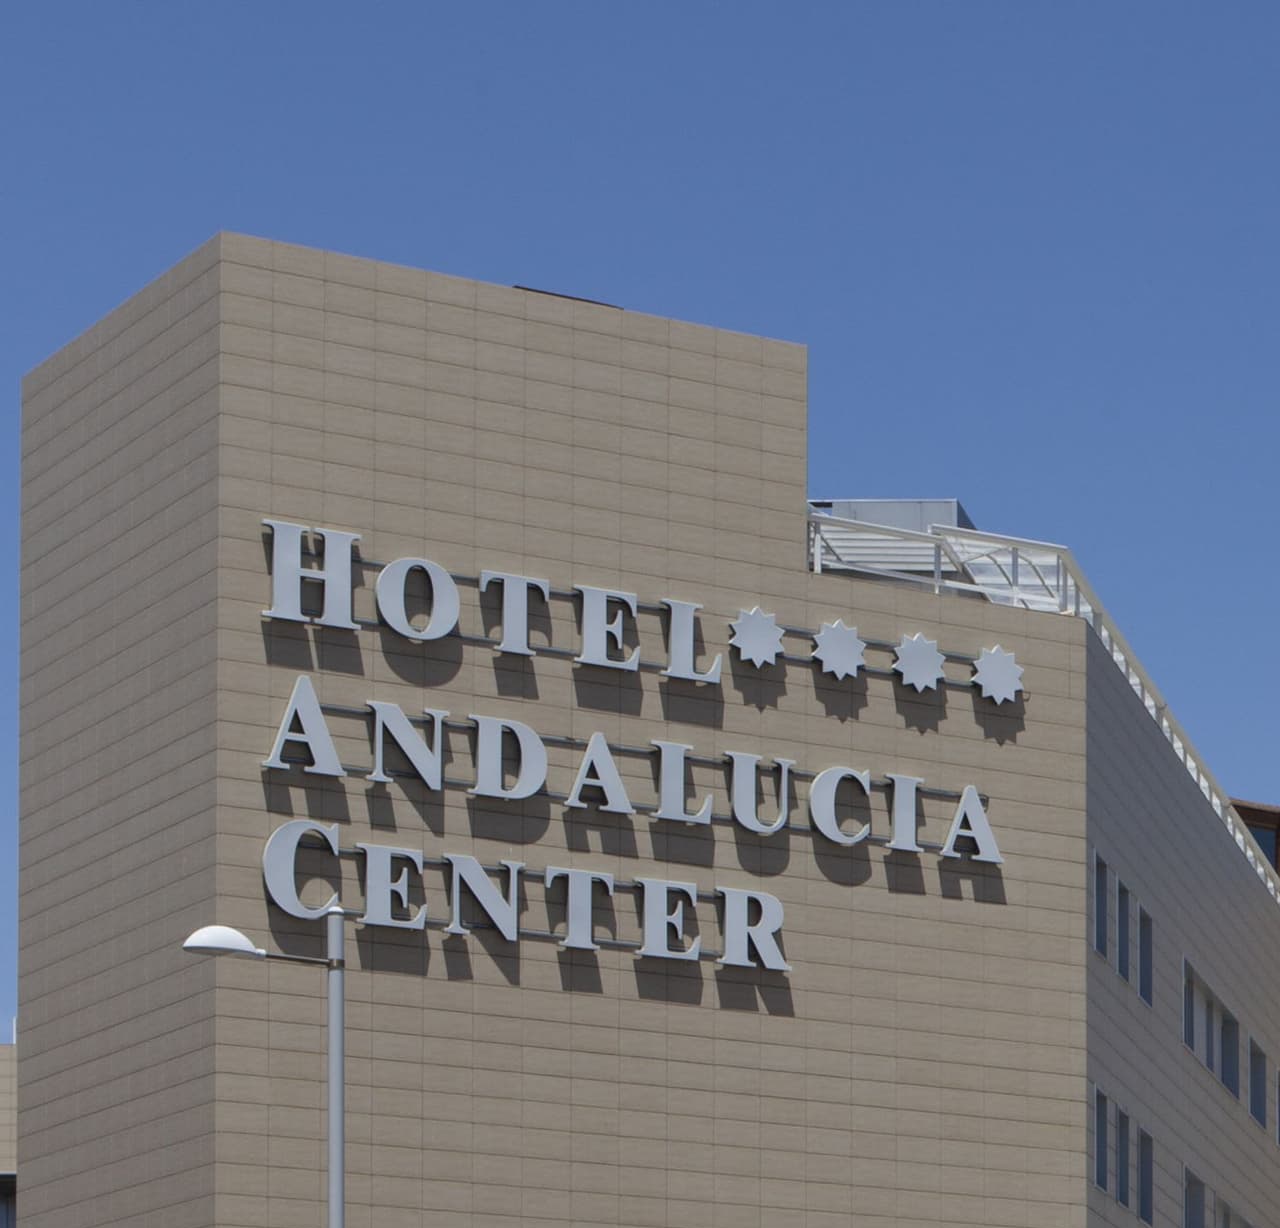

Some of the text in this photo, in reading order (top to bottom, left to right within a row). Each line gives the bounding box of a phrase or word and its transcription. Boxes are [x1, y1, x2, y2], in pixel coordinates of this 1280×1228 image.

[262, 519, 723, 685] HOTEL
[262, 675, 1004, 865] ANDALUCIA
[262, 820, 793, 972] CENTER
